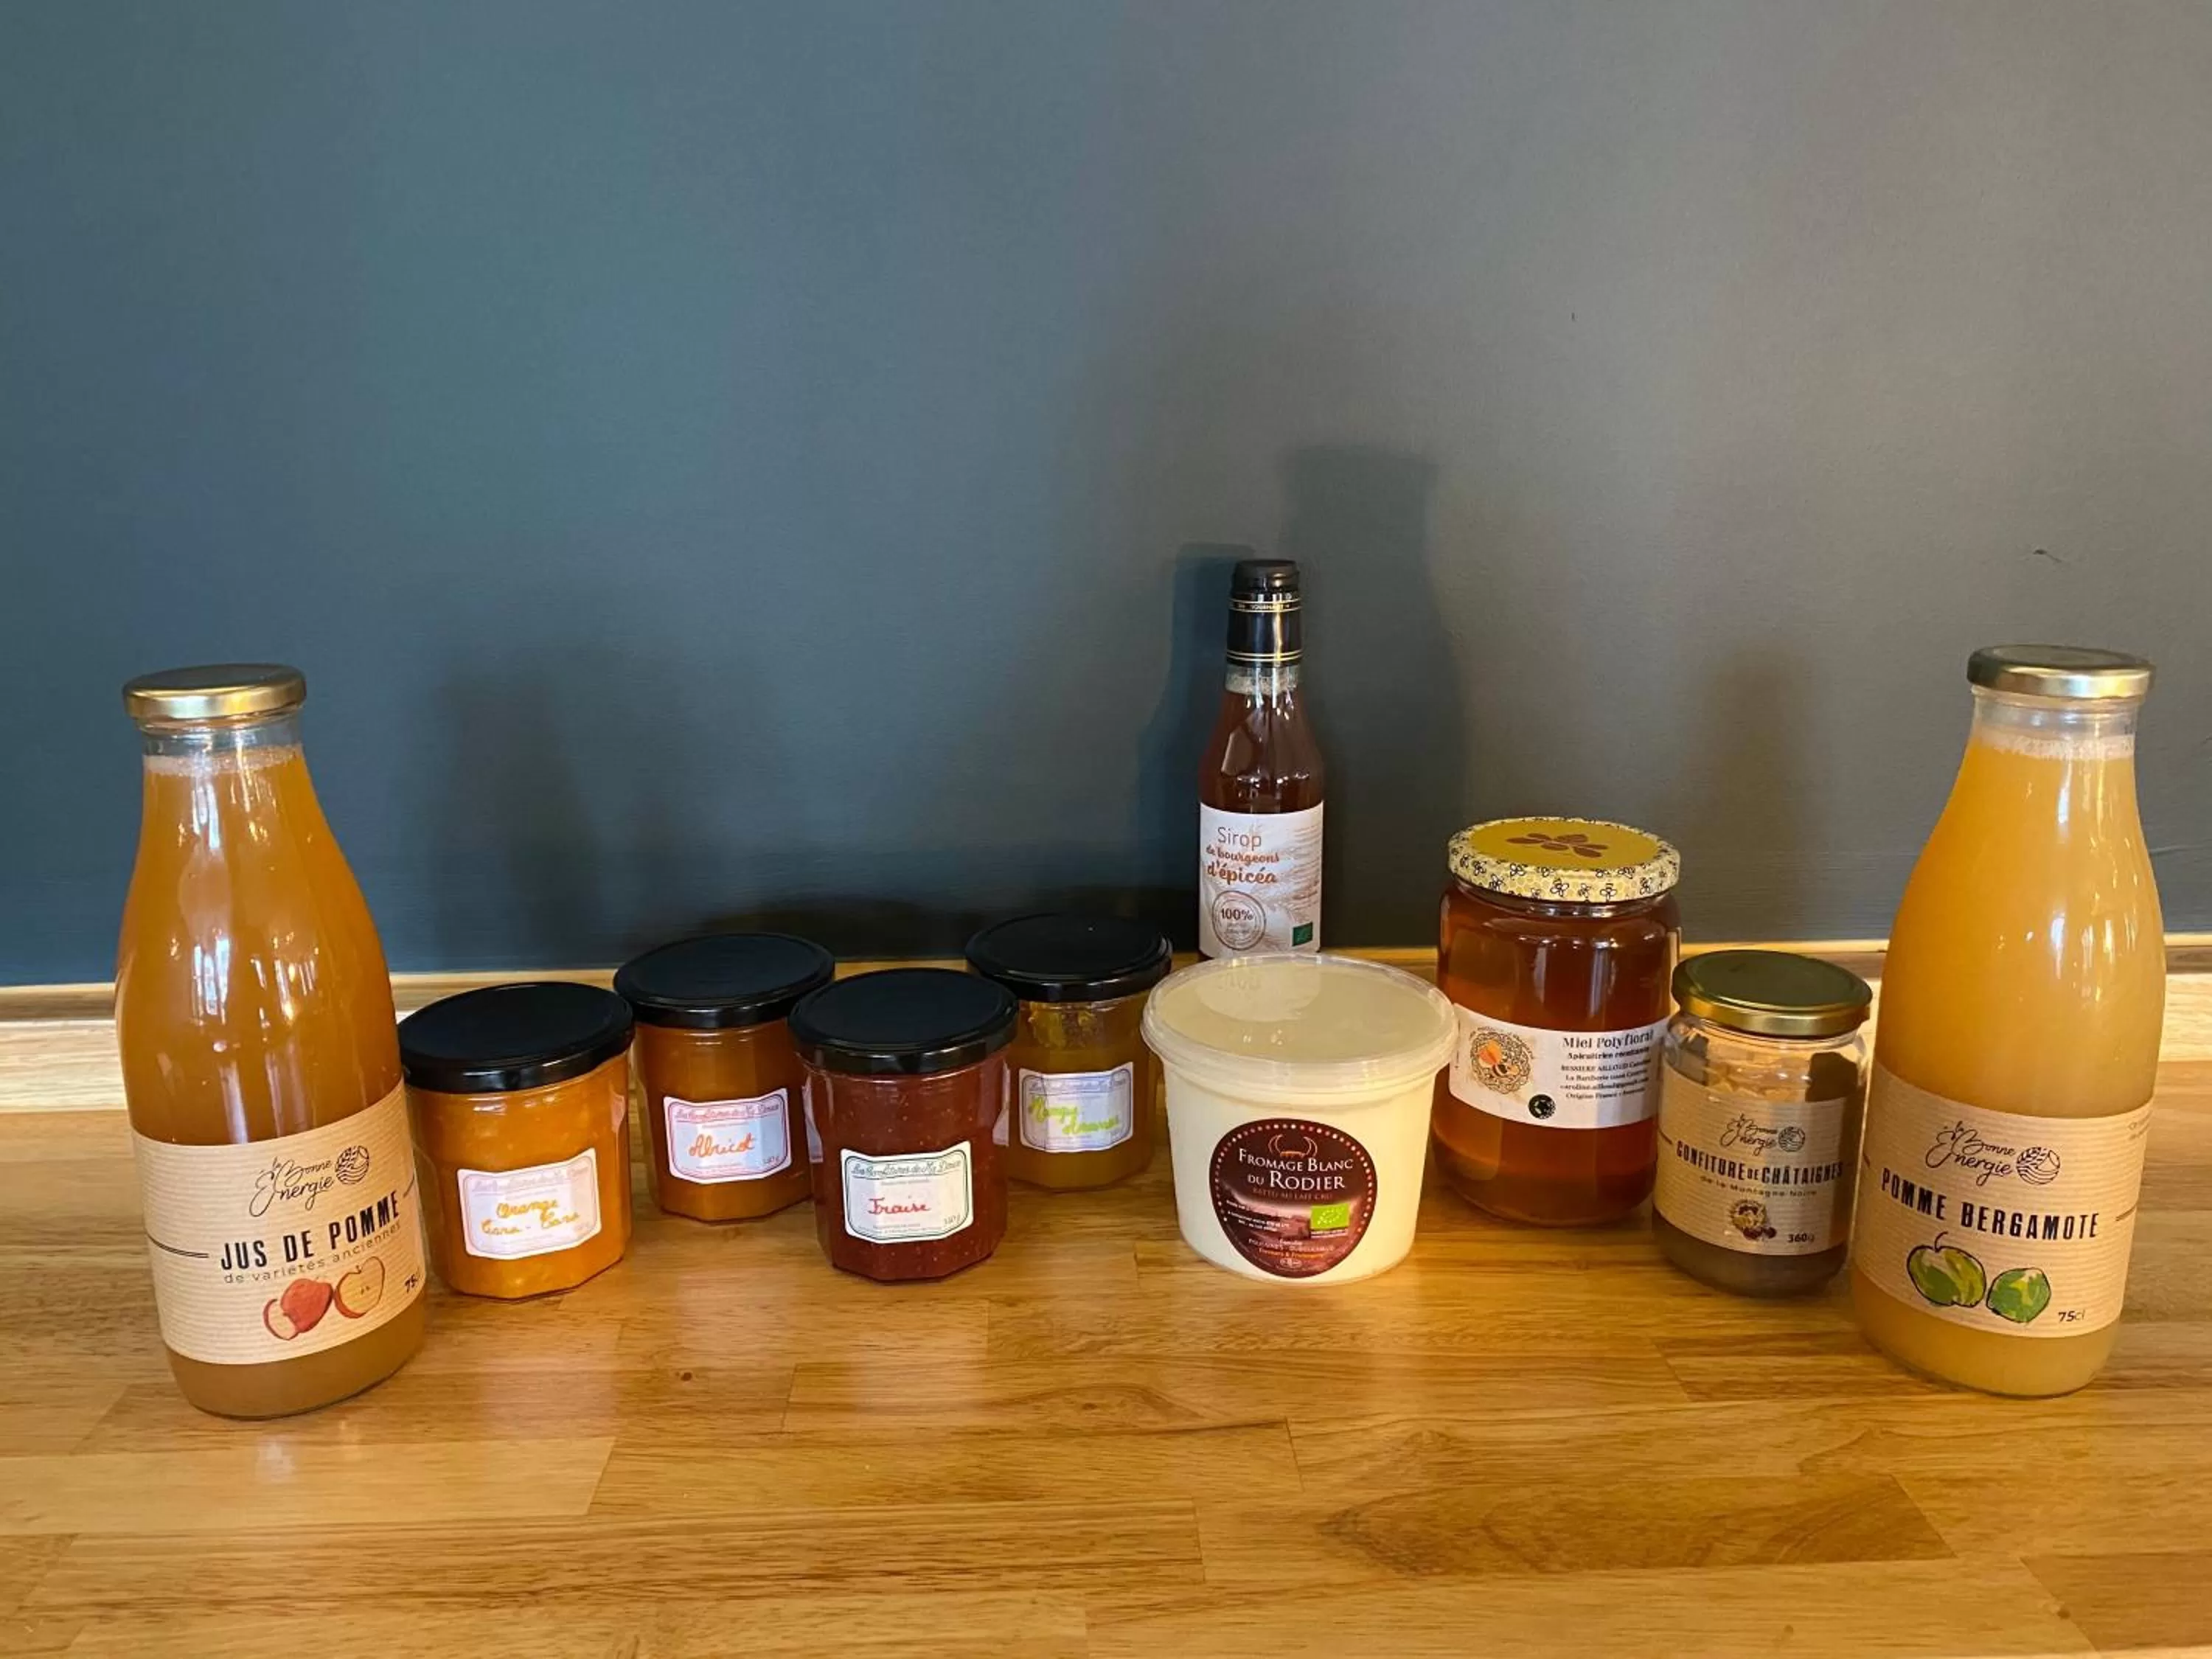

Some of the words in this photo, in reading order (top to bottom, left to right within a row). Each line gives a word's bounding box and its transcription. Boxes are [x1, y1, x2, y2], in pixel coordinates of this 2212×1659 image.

[1217, 827, 1262, 851] Sirop
[1217, 846, 1279, 866] bourgeons
[1207, 860, 1278, 885] d'épicéa
[1221, 908, 1254, 921] 100%
[1563, 1037, 1592, 1048] Miel
[1597, 1029, 1655, 1049] Polyfloral
[689, 1133, 756, 1158] Abricot
[1951, 1129, 2017, 1156] Bonne
[1676, 1140, 1746, 1181] CONFITURE
[1747, 1169, 1759, 1181] DE
[1761, 1161, 1844, 1186] CHÂTAIGNES
[867, 1196, 931, 1215] Fraise
[1881, 1166, 1947, 1221] POMME
[1960, 1201, 2100, 1241] BERGAMOTE
[220, 1239, 268, 1270] JUS
[283, 1229, 314, 1263] DE
[328, 1190, 400, 1250] POMME
[223, 1273, 245, 1284] de
[331, 1220, 402, 1264] anciennes
[2057, 1310, 2086, 1323] 75cl
